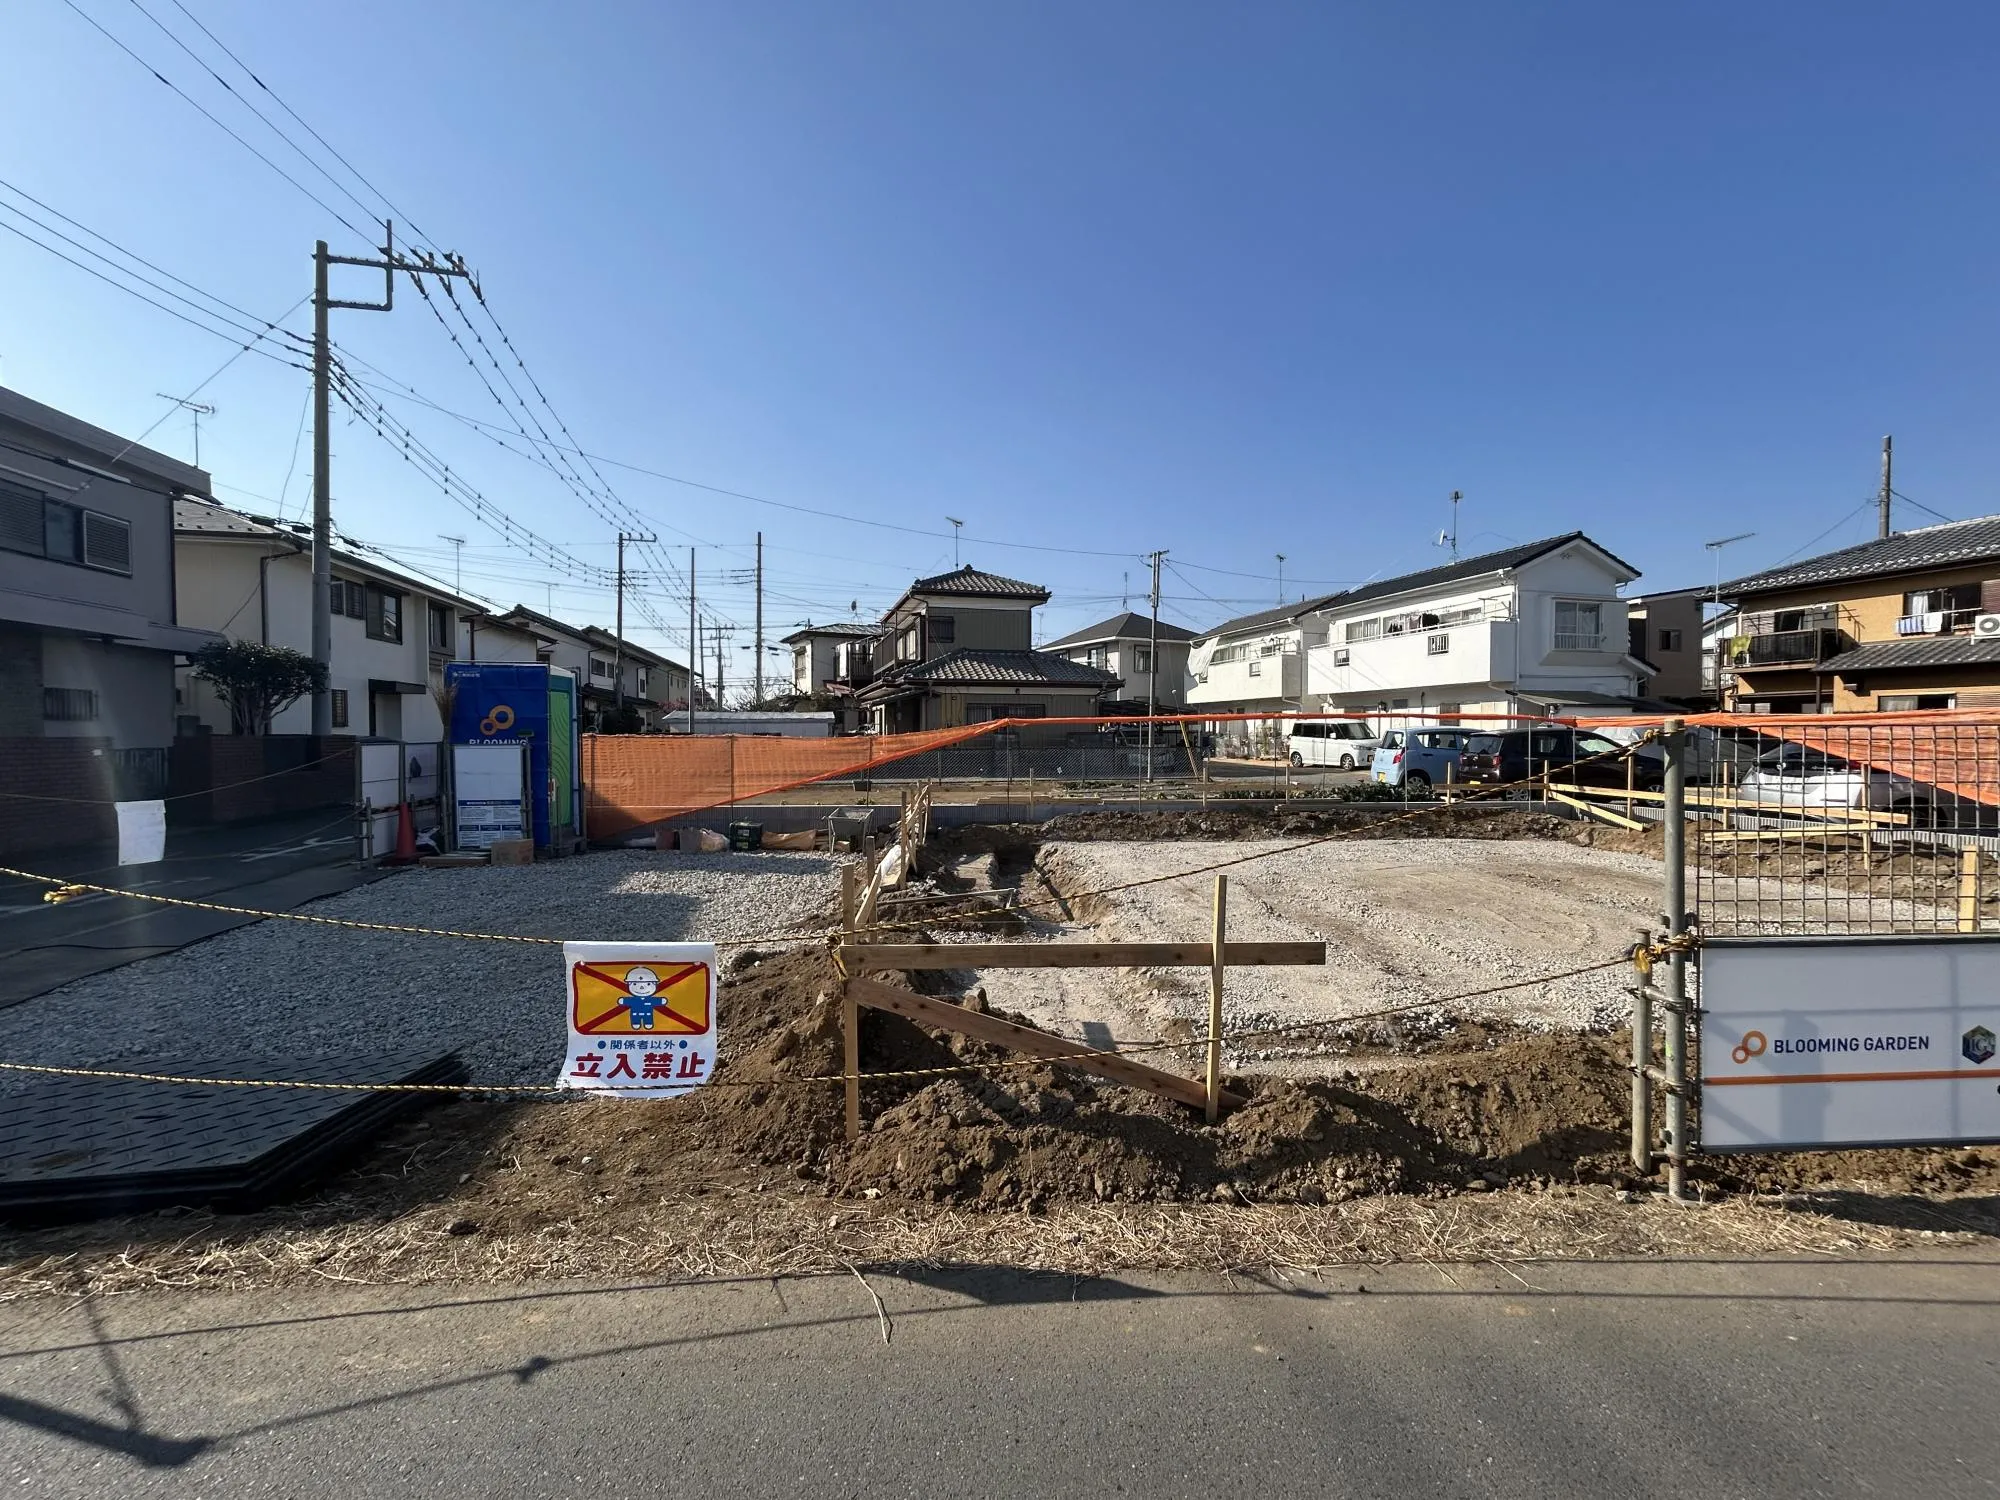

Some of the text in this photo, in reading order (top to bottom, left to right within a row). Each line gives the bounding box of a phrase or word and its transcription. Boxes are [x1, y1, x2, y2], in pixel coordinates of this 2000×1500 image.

[609, 1039, 676, 1051] 関係者以外
[1774, 1035, 1930, 1054] BLOOMING GARDEN
[570, 1052, 706, 1079] 立入禁止
